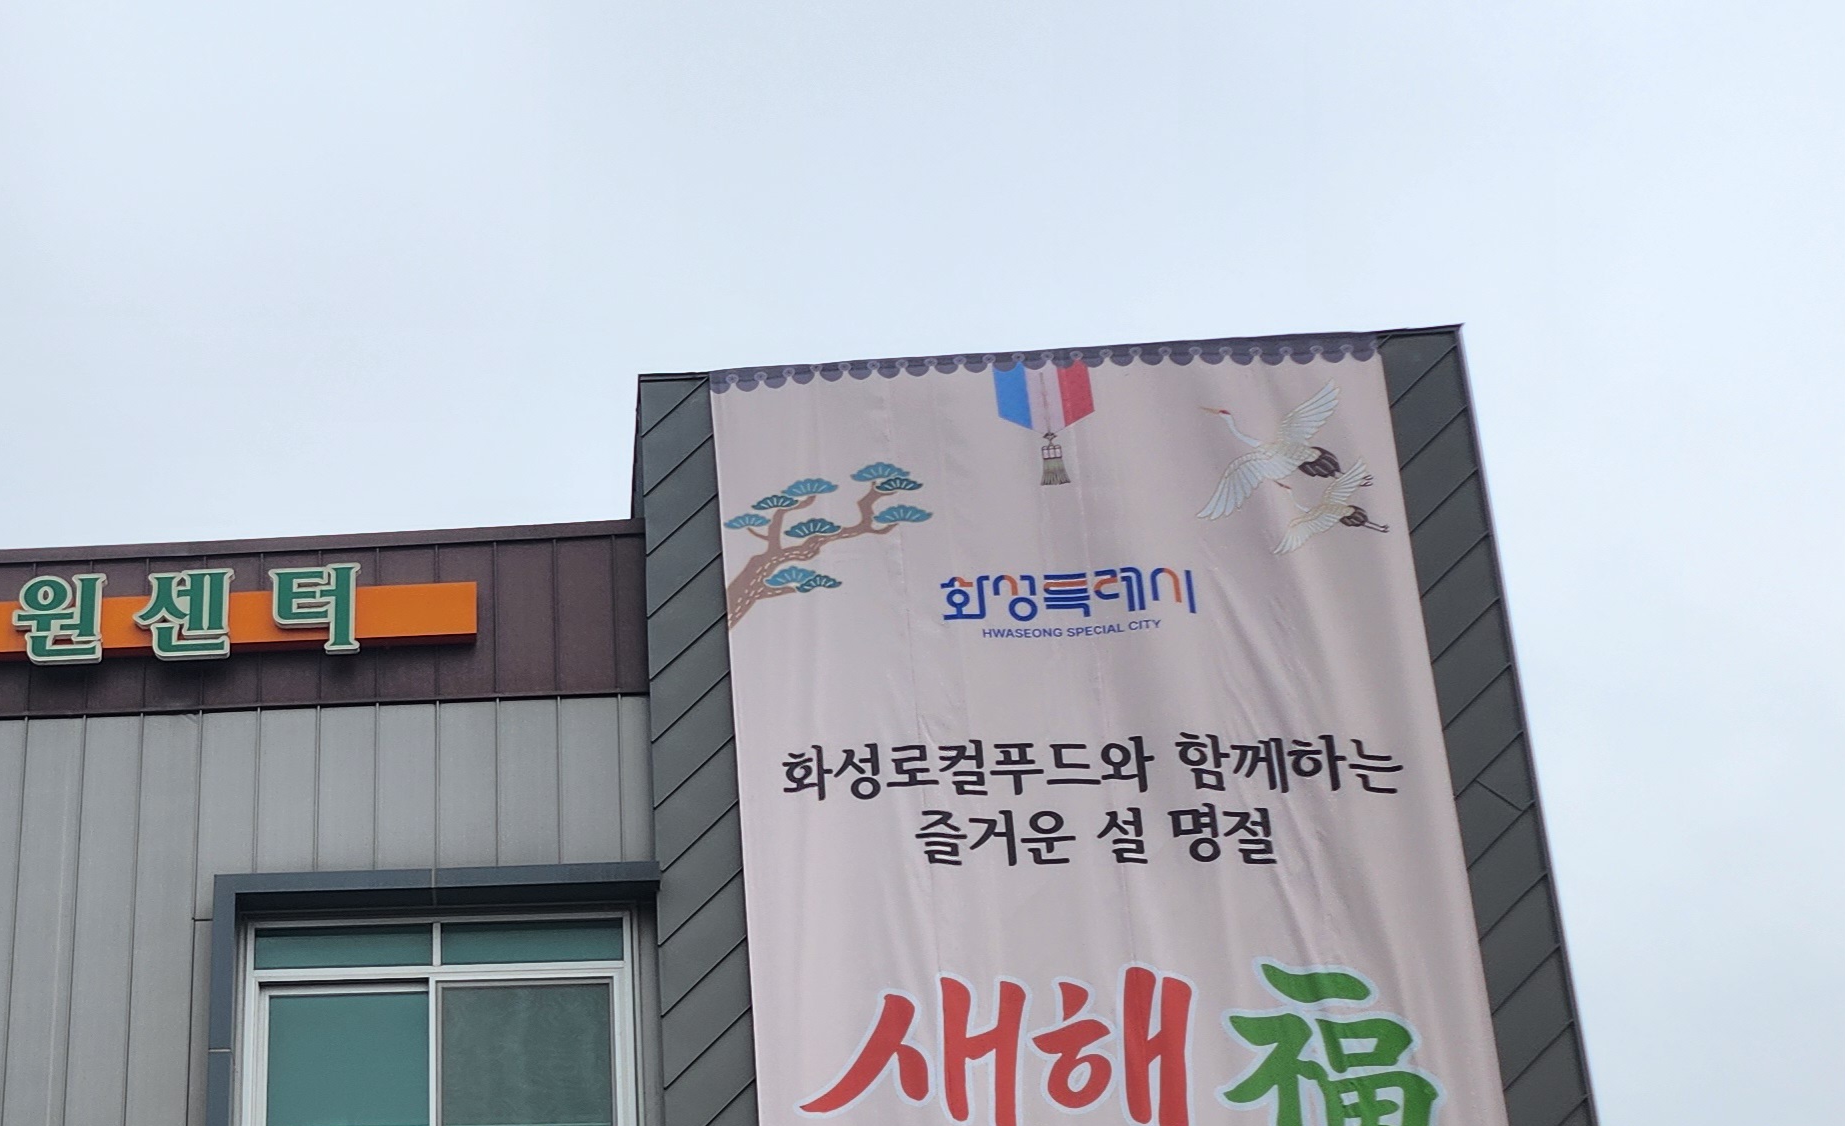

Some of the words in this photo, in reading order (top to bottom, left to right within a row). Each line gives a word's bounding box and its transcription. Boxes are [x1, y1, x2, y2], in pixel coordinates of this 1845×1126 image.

[940, 566, 1196, 622] 화성특례시
[981, 626, 1063, 639] HWASEONG
[1066, 620, 1125, 638] SPECIAL
[1127, 618, 1162, 632] CITY
[781, 735, 1155, 802] 화성로컬푸드와
[1173, 731, 1404, 795] 함께하는
[914, 810, 1076, 866] 즐거운
[1096, 807, 1148, 867] 설
[1166, 802, 1278, 866] 명절
